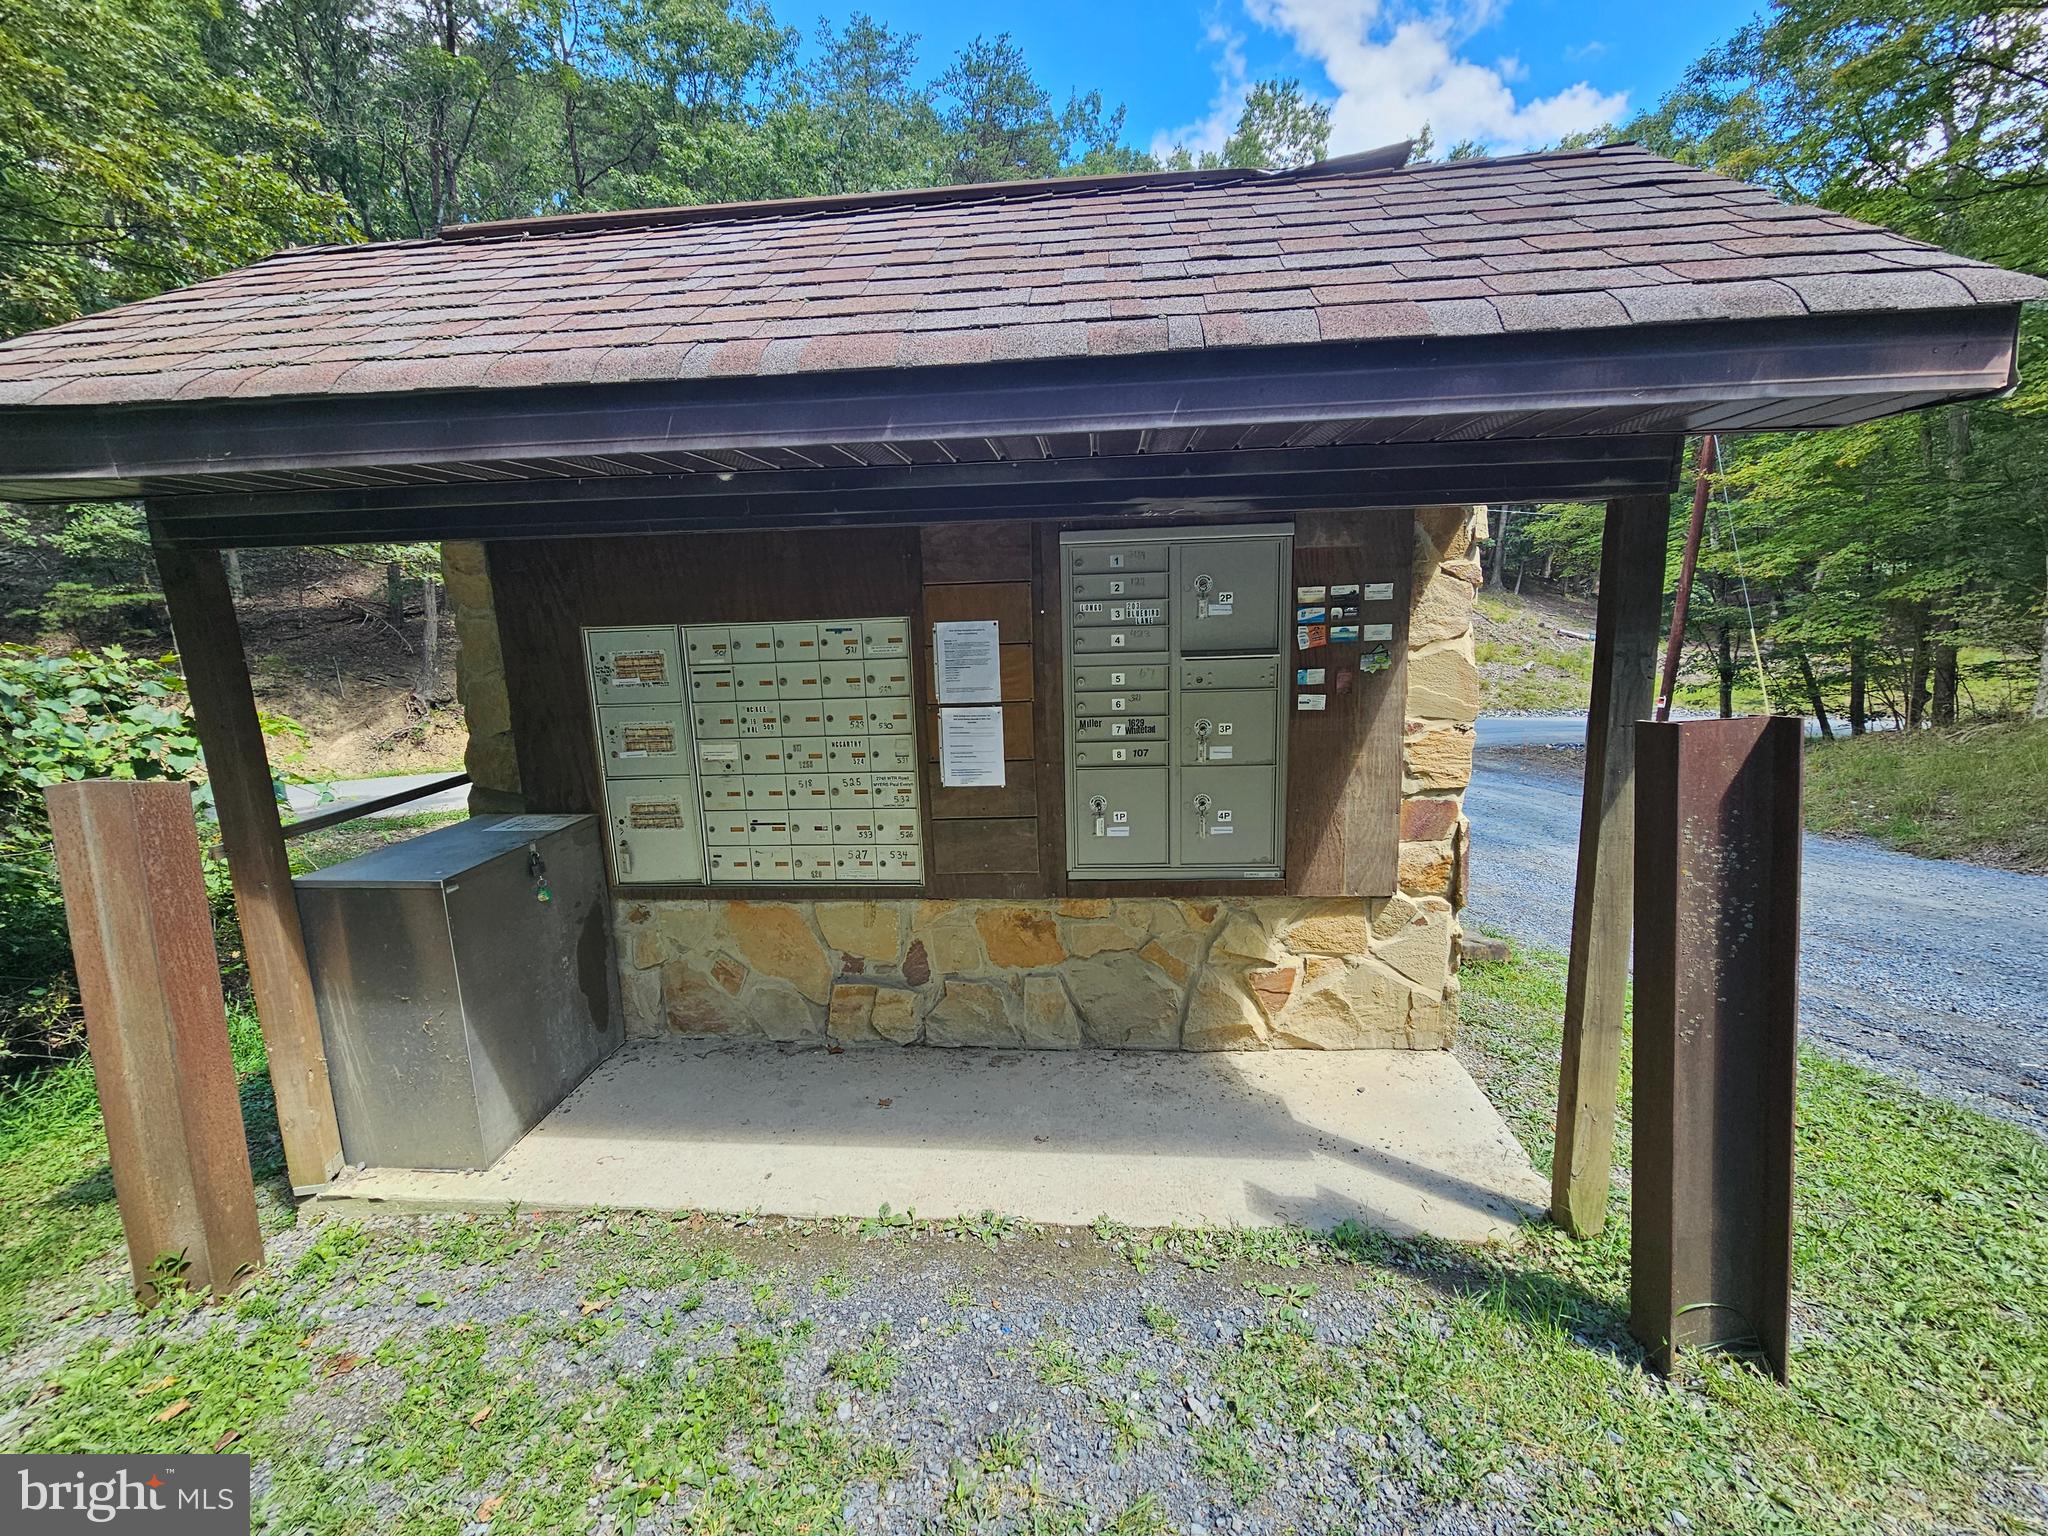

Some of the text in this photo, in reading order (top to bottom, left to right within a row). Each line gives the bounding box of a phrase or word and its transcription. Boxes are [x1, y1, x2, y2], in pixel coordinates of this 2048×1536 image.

[1114, 557, 1119, 565] 1
[1114, 584, 1120, 592] 2
[1220, 594, 1232, 602] 2P
[1115, 610, 1121, 618] 3
[1127, 609, 1159, 617] BLUEBIRD
[1114, 636, 1121, 644] 4
[1115, 675, 1121, 683] 5
[1115, 700, 1121, 708] 6
[850, 721, 864, 729] 523
[878, 722, 893, 730] 530
[1079, 719, 1102, 728] Miller
[1115, 726, 1121, 734] 7
[1219, 725, 1231, 733] 3P
[831, 740, 862, 748] MCCARTHY
[1116, 751, 1122, 759] 8
[1133, 748, 1149, 758] 107
[798, 778, 813, 788] 518
[842, 778, 862, 787] 525
[893, 795, 910, 803] 532
[1114, 813, 1126, 821] 1P
[1218, 812, 1231, 820] 4P
[847, 850, 868, 860] 527
[889, 850, 908, 861] 534
